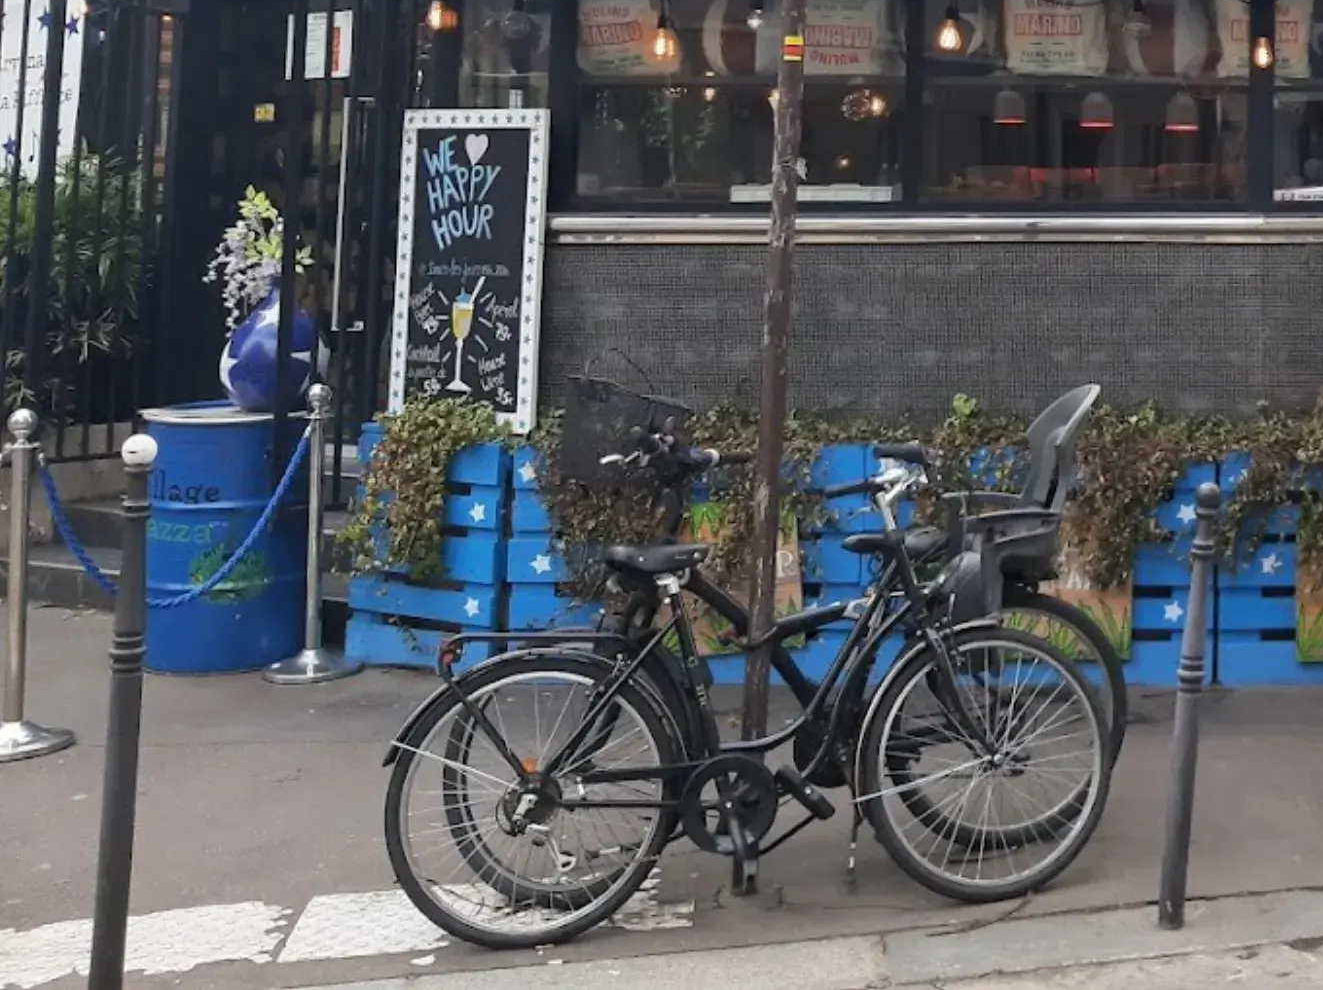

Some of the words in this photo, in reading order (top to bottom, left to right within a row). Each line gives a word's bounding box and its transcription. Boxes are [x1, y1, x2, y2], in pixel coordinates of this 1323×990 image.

[422, 135, 458, 178] WE
[427, 164, 502, 214] HAPPY
[432, 204, 495, 250] HOUR
[152, 469, 221, 505] llage
